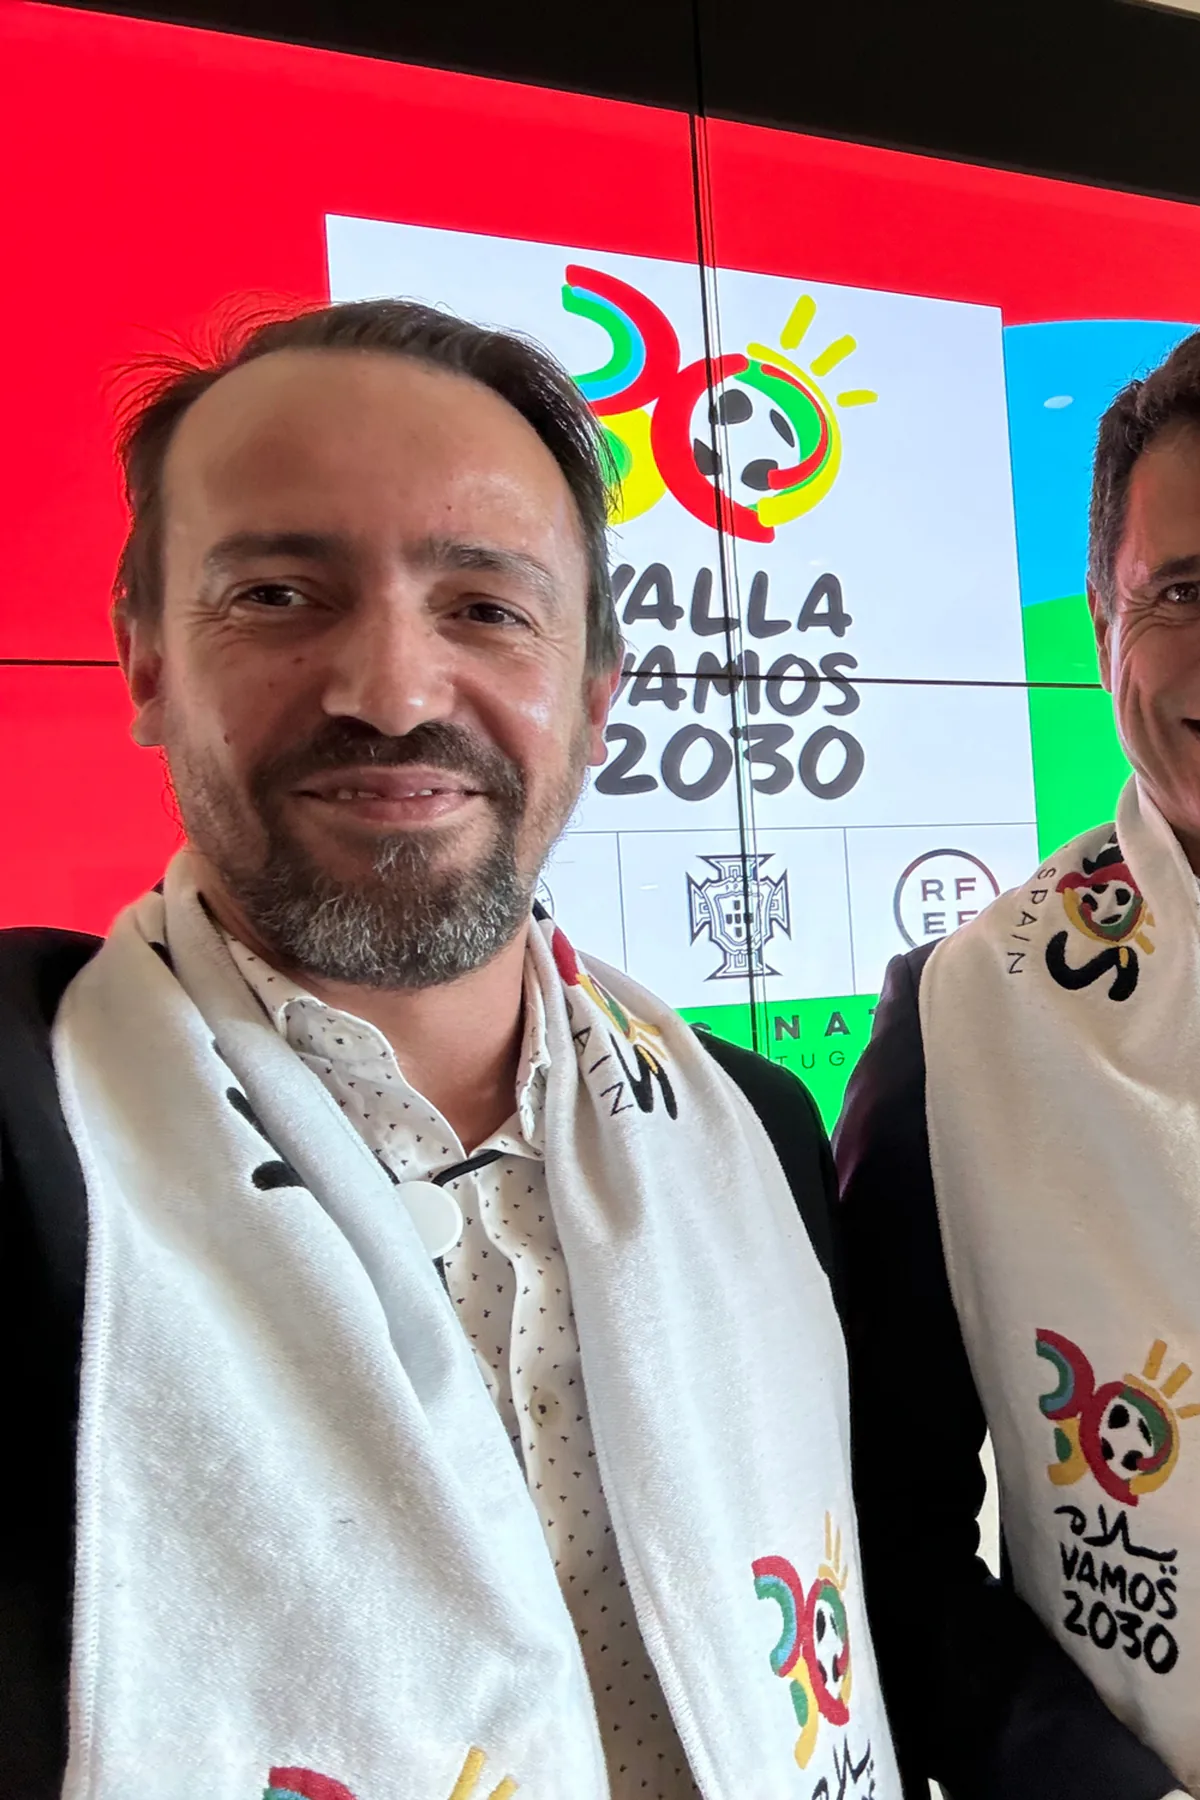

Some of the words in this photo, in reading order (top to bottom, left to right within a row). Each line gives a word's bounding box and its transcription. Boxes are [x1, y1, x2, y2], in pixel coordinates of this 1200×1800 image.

[594, 722, 865, 802] 2030
[1006, 866, 1057, 975] SPAIN
[1059, 1540, 1178, 1621] VAMOS
[1062, 1590, 1180, 1675] 2030
